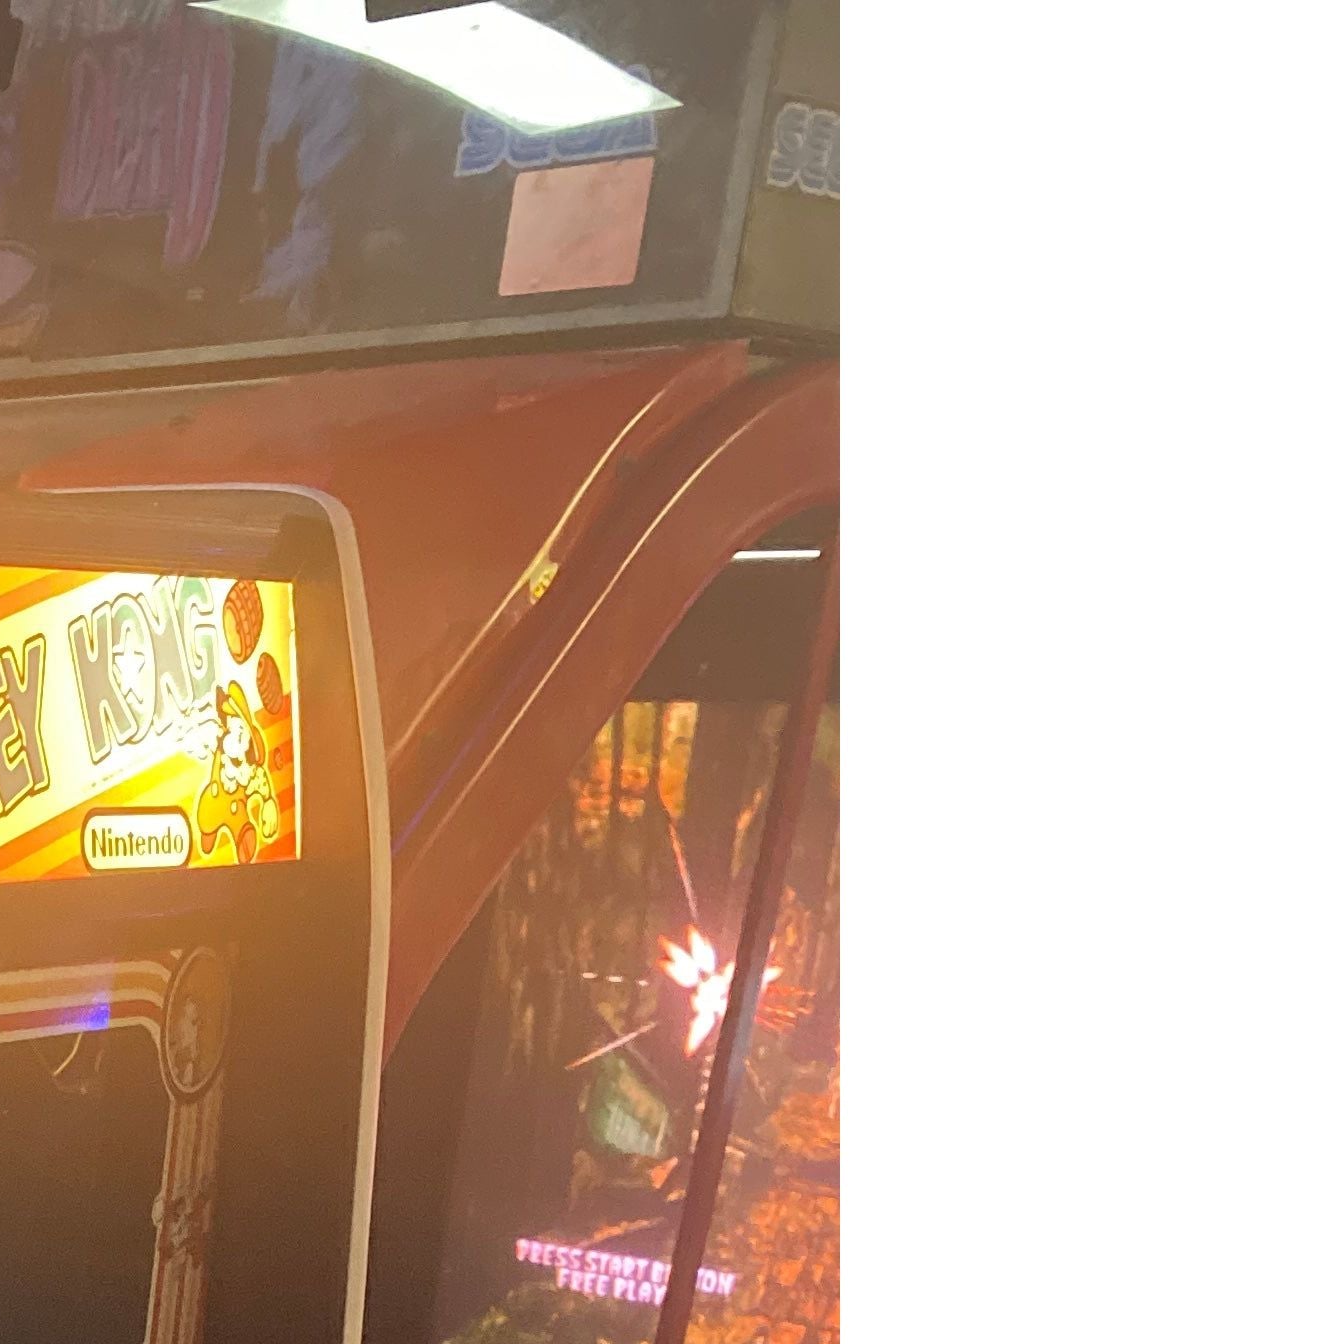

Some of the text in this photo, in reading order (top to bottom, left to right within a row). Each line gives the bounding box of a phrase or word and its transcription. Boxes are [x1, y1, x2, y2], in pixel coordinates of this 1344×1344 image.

[68, 576, 221, 763] KONG
[91, 826, 184, 859] Nintendo
[515, 1238, 583, 1271] PRESS
[584, 1250, 649, 1279] START
[557, 1267, 666, 1305] FREE PLAY
